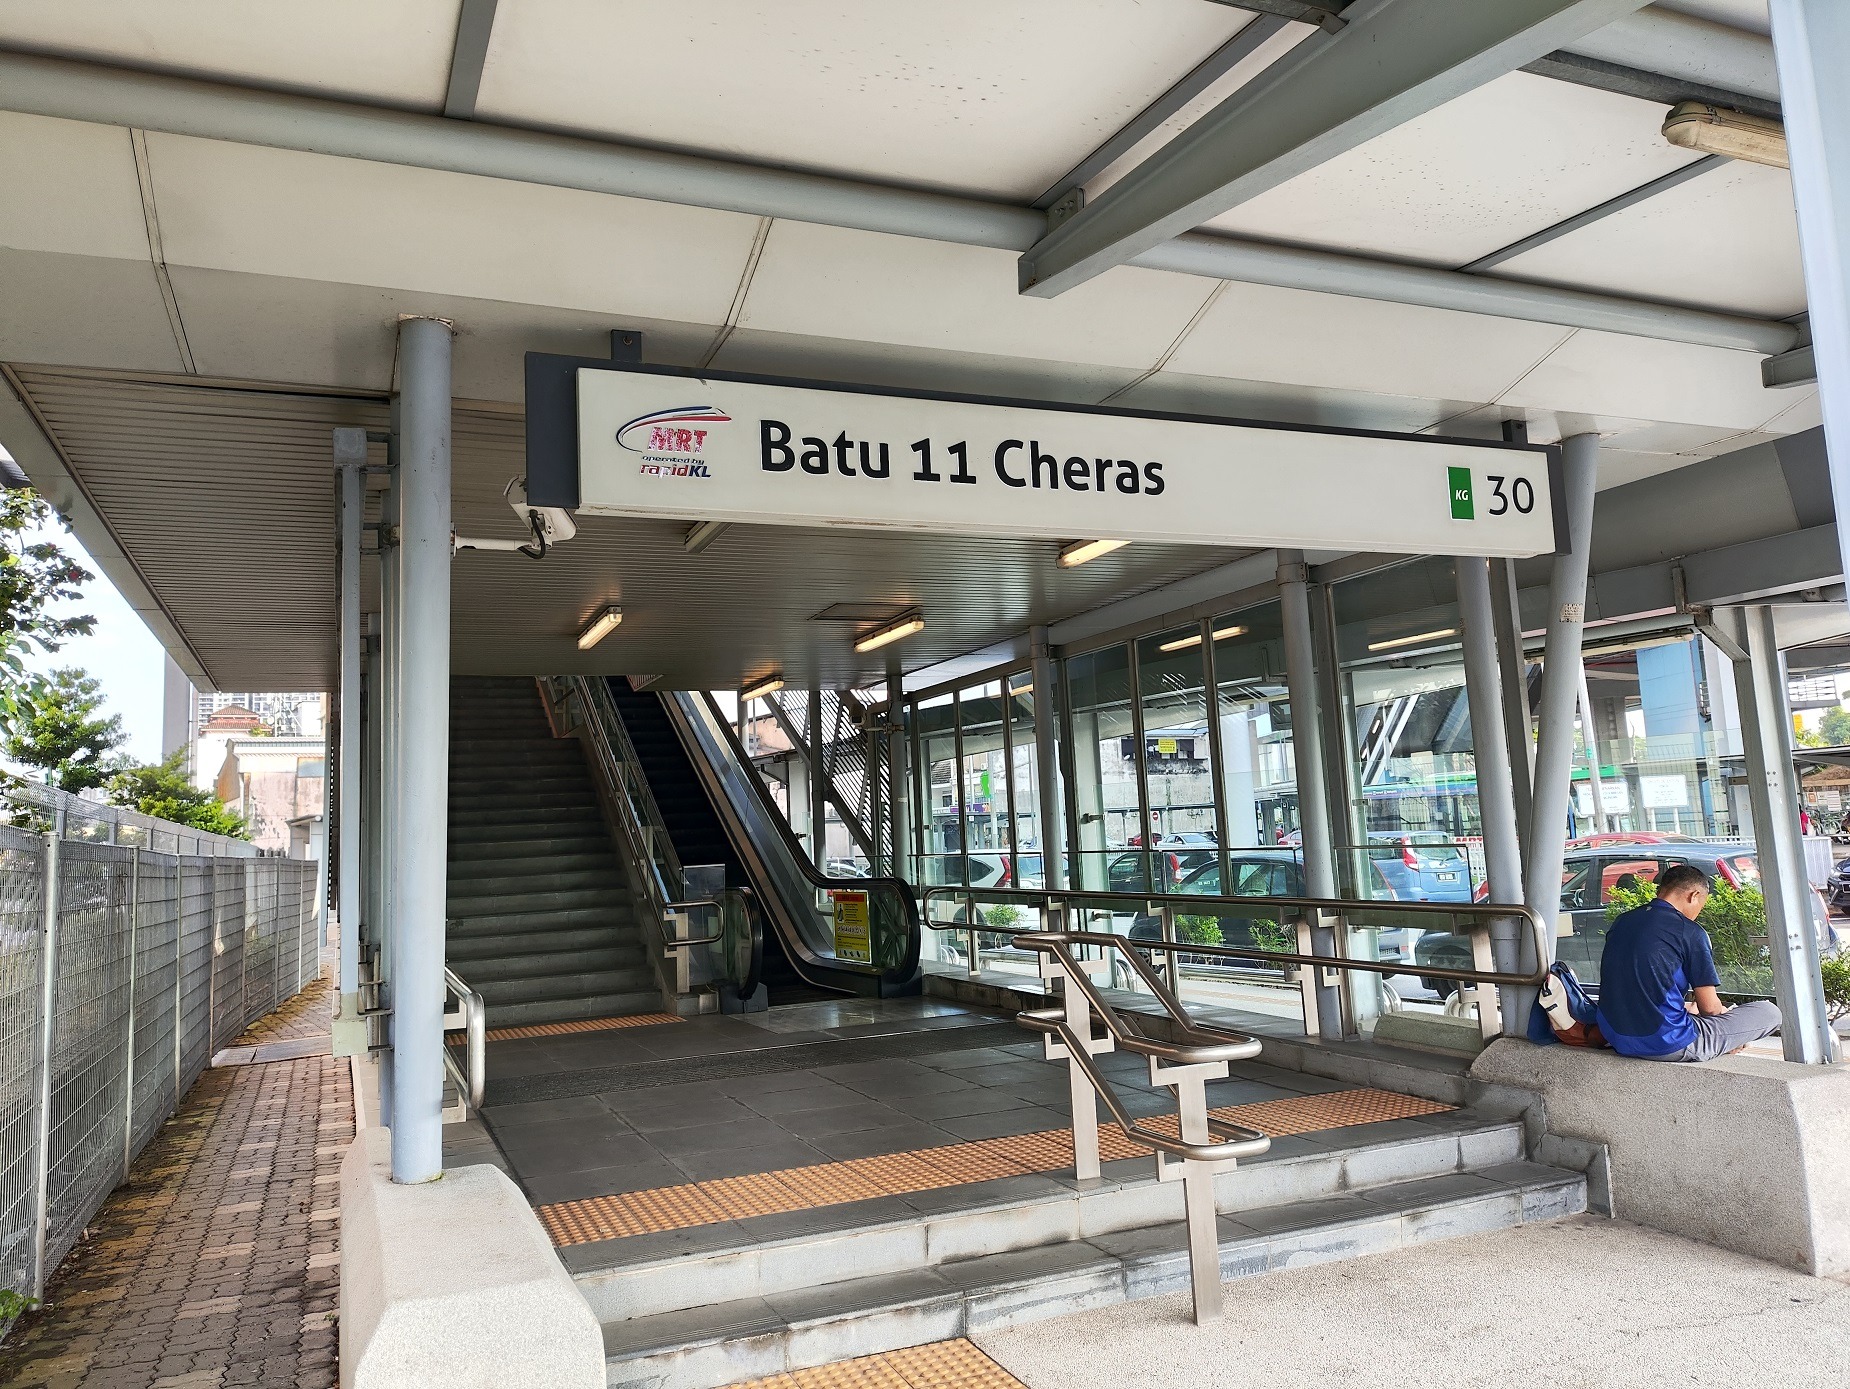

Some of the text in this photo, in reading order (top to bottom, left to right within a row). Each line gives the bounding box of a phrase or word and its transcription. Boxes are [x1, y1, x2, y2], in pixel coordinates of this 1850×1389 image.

[648, 427, 707, 453] MRT
[642, 455, 705, 466] operated by
[760, 419, 1165, 496] Batu 11 Cheras
[640, 464, 711, 479] rapidKL
[1455, 490, 1468, 500] KG
[1487, 476, 1534, 515] 30
